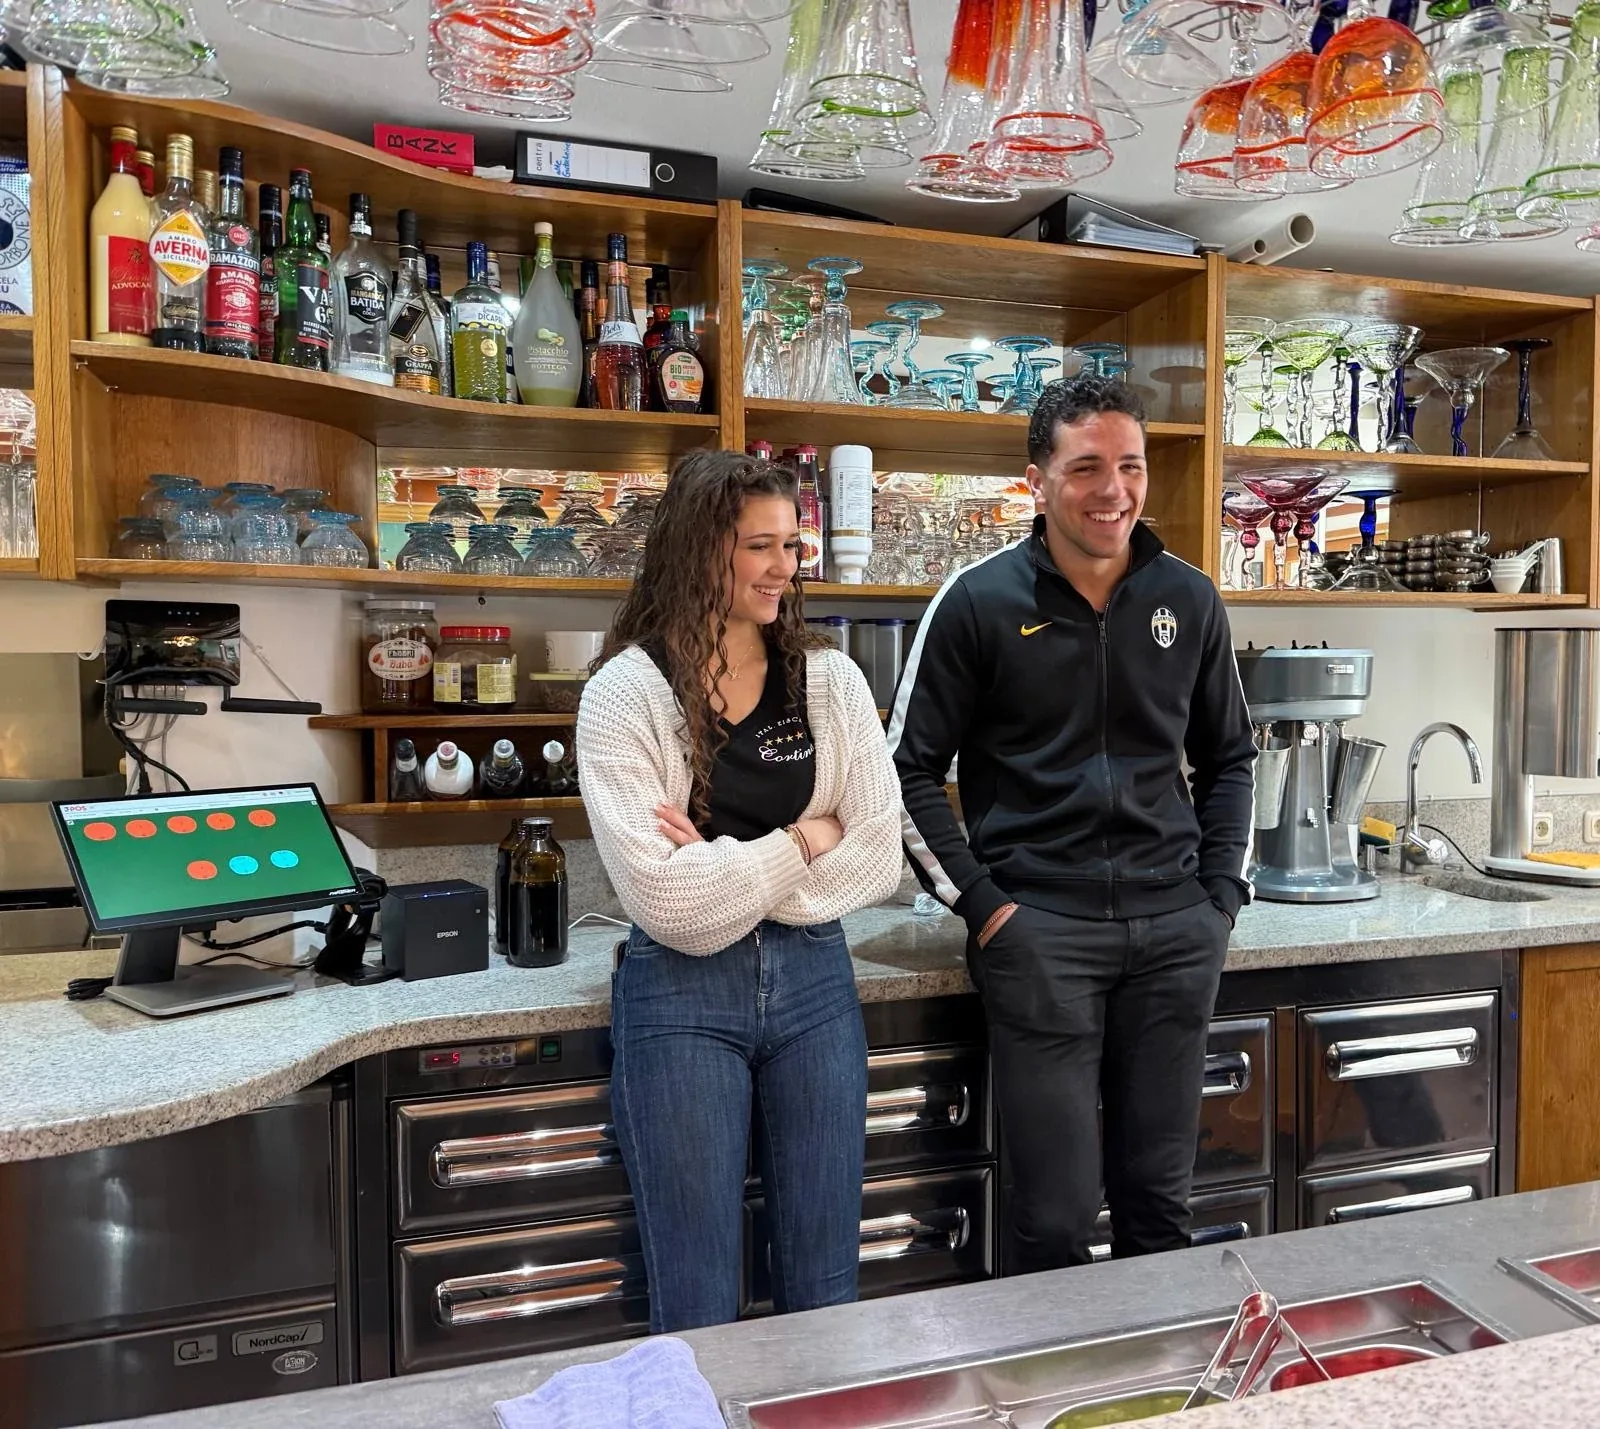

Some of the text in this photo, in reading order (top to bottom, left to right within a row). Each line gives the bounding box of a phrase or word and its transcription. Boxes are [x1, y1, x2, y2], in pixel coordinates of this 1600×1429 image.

[387, 134, 457, 155] BANK
[535, 142, 543, 171] centra
[0, 220, 30, 266] ORBONE
[168, 234, 198, 245] AMARO
[153, 240, 209, 265] AVERNA
[163, 254, 202, 265] SICILIANO
[220, 271, 255, 286] AMARO
[299, 286, 329, 306] VA
[350, 296, 385, 311] BATIDA
[227, 323, 250, 331] MILANO
[527, 345, 569, 356] Pistacchio
[405, 359, 433, 371] GRAPPA
[531, 363, 567, 371] BOTTEGA
[436, 930, 459, 939] EPSON
[249, 1332, 300, 1349] NordCap
